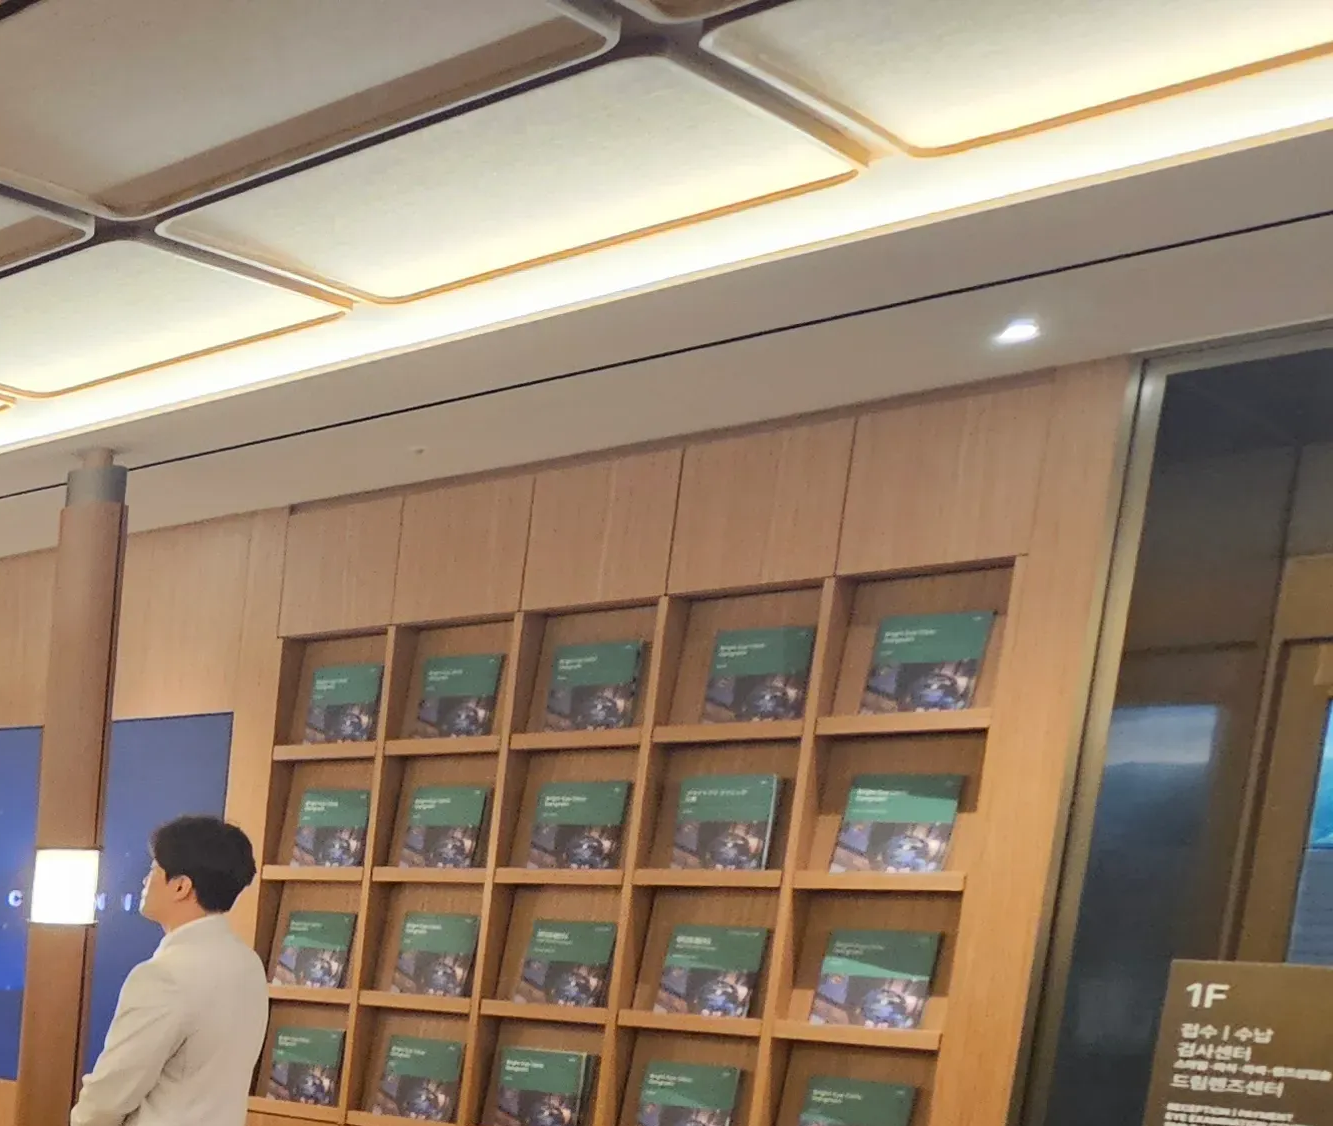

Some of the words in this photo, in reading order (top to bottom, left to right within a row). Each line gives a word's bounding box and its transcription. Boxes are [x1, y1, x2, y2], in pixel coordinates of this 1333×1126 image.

[1186, 982, 1231, 1009] 1F
[1234, 1026, 1275, 1044] 수납
[1177, 1042, 1252, 1062] 검사센터
